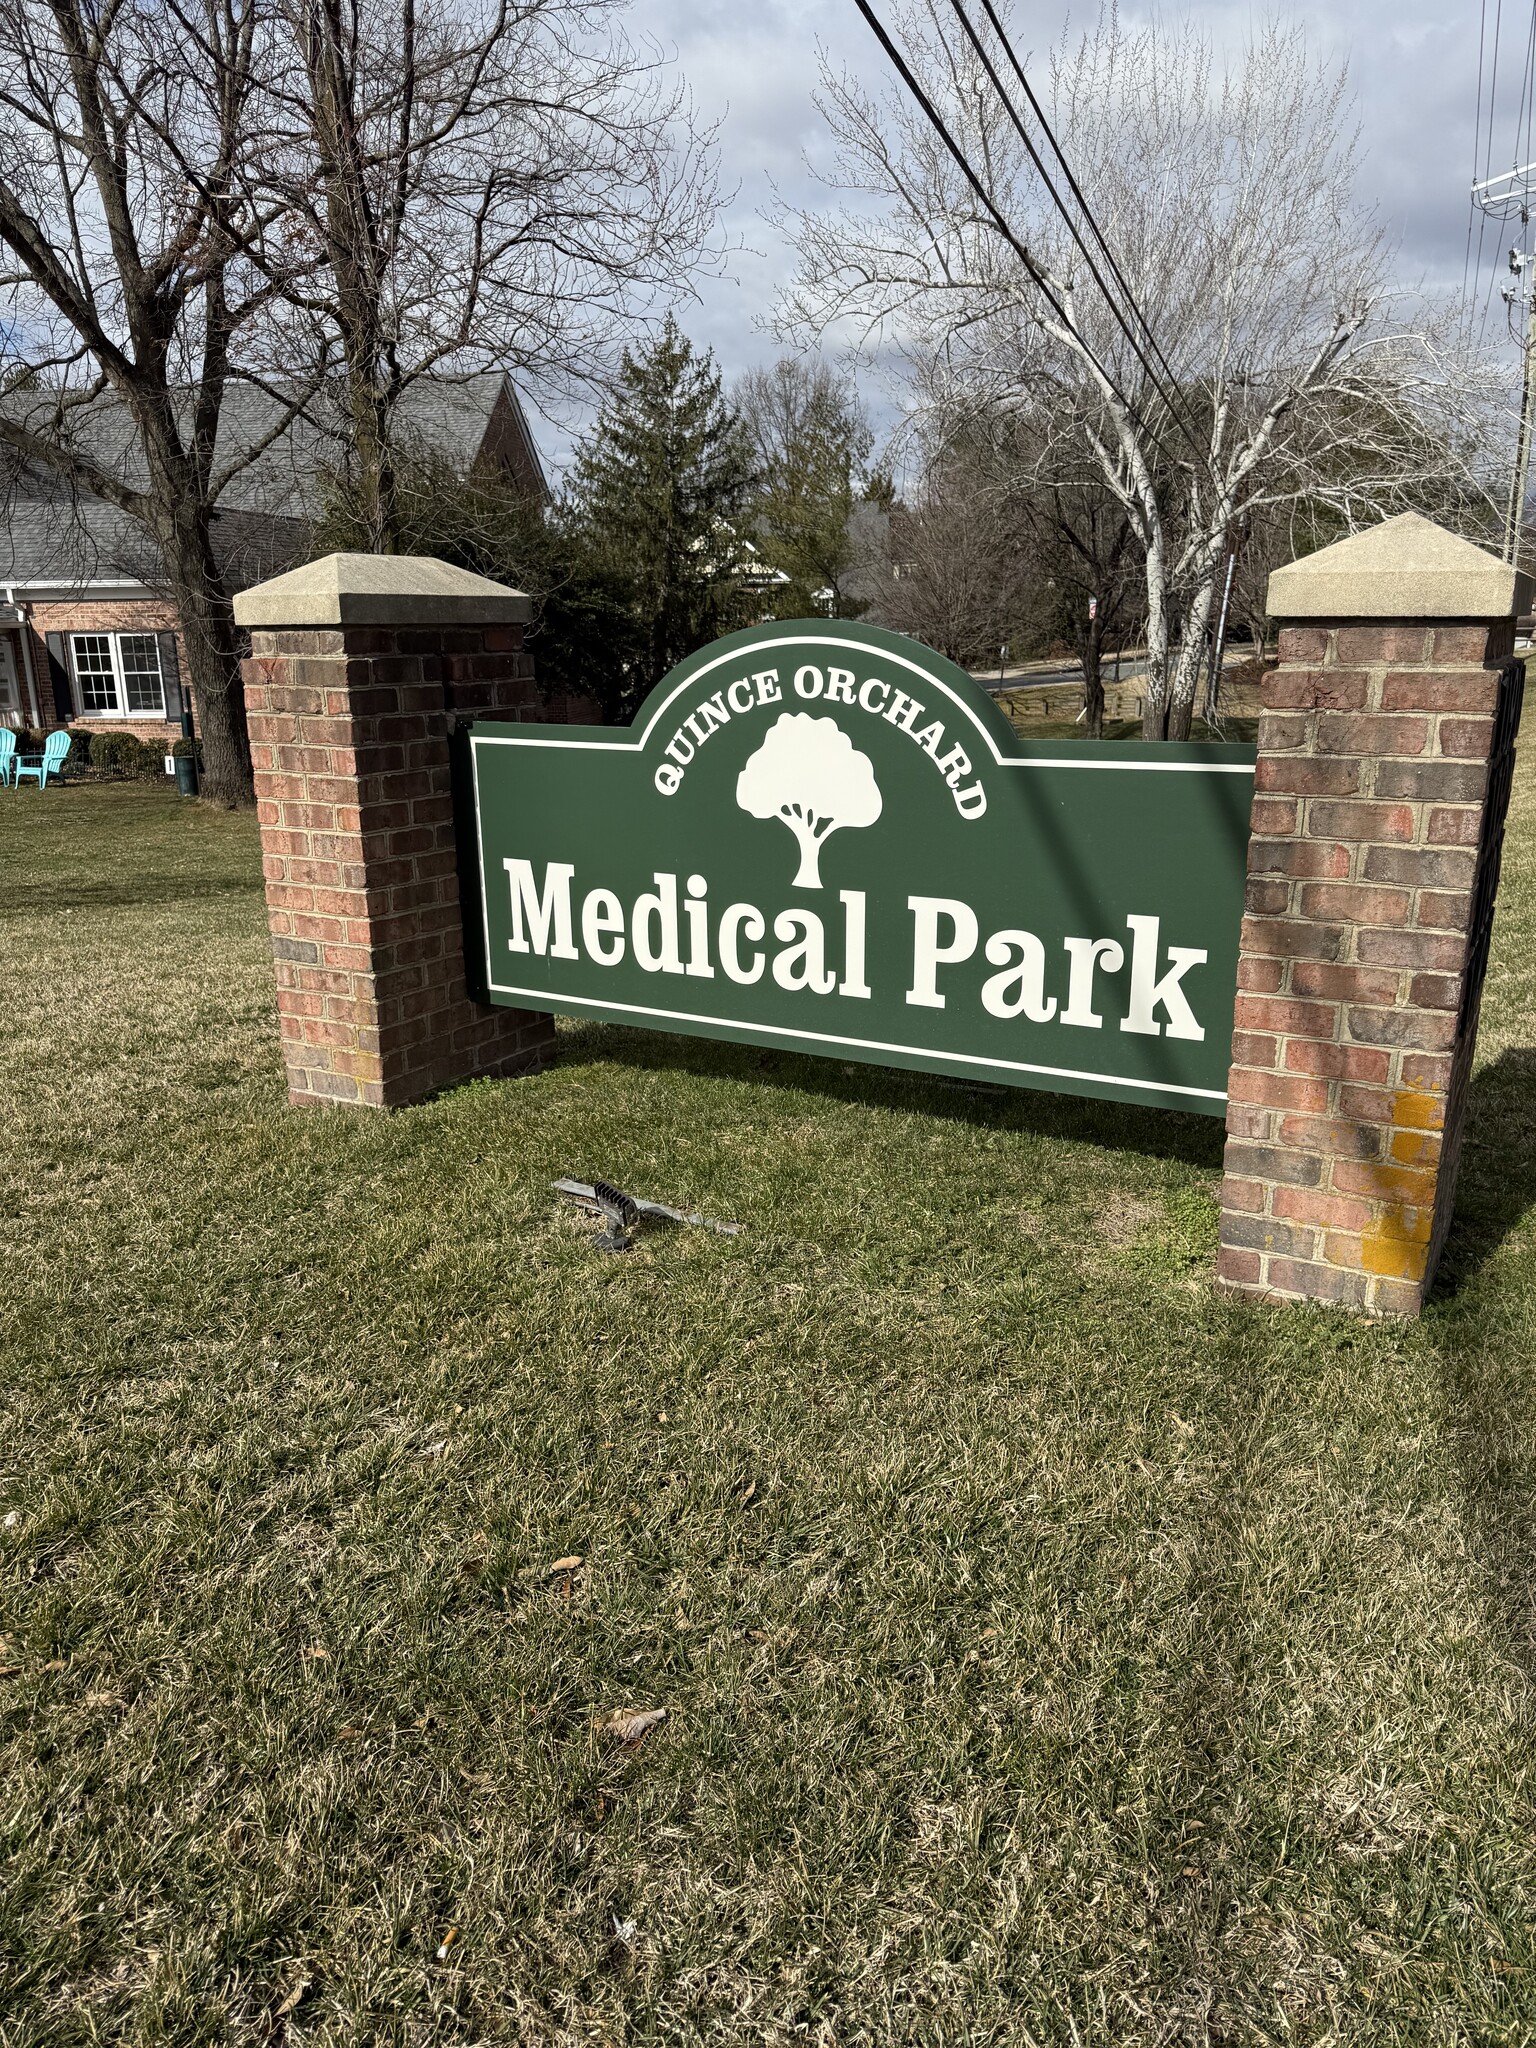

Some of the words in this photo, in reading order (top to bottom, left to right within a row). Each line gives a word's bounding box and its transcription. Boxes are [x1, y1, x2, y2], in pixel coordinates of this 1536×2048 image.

[654, 668, 783, 797] QUINCE
[793, 664, 988, 821] ORCHARD
[502, 857, 872, 1000] Medical
[905, 895, 1208, 1042] Park
